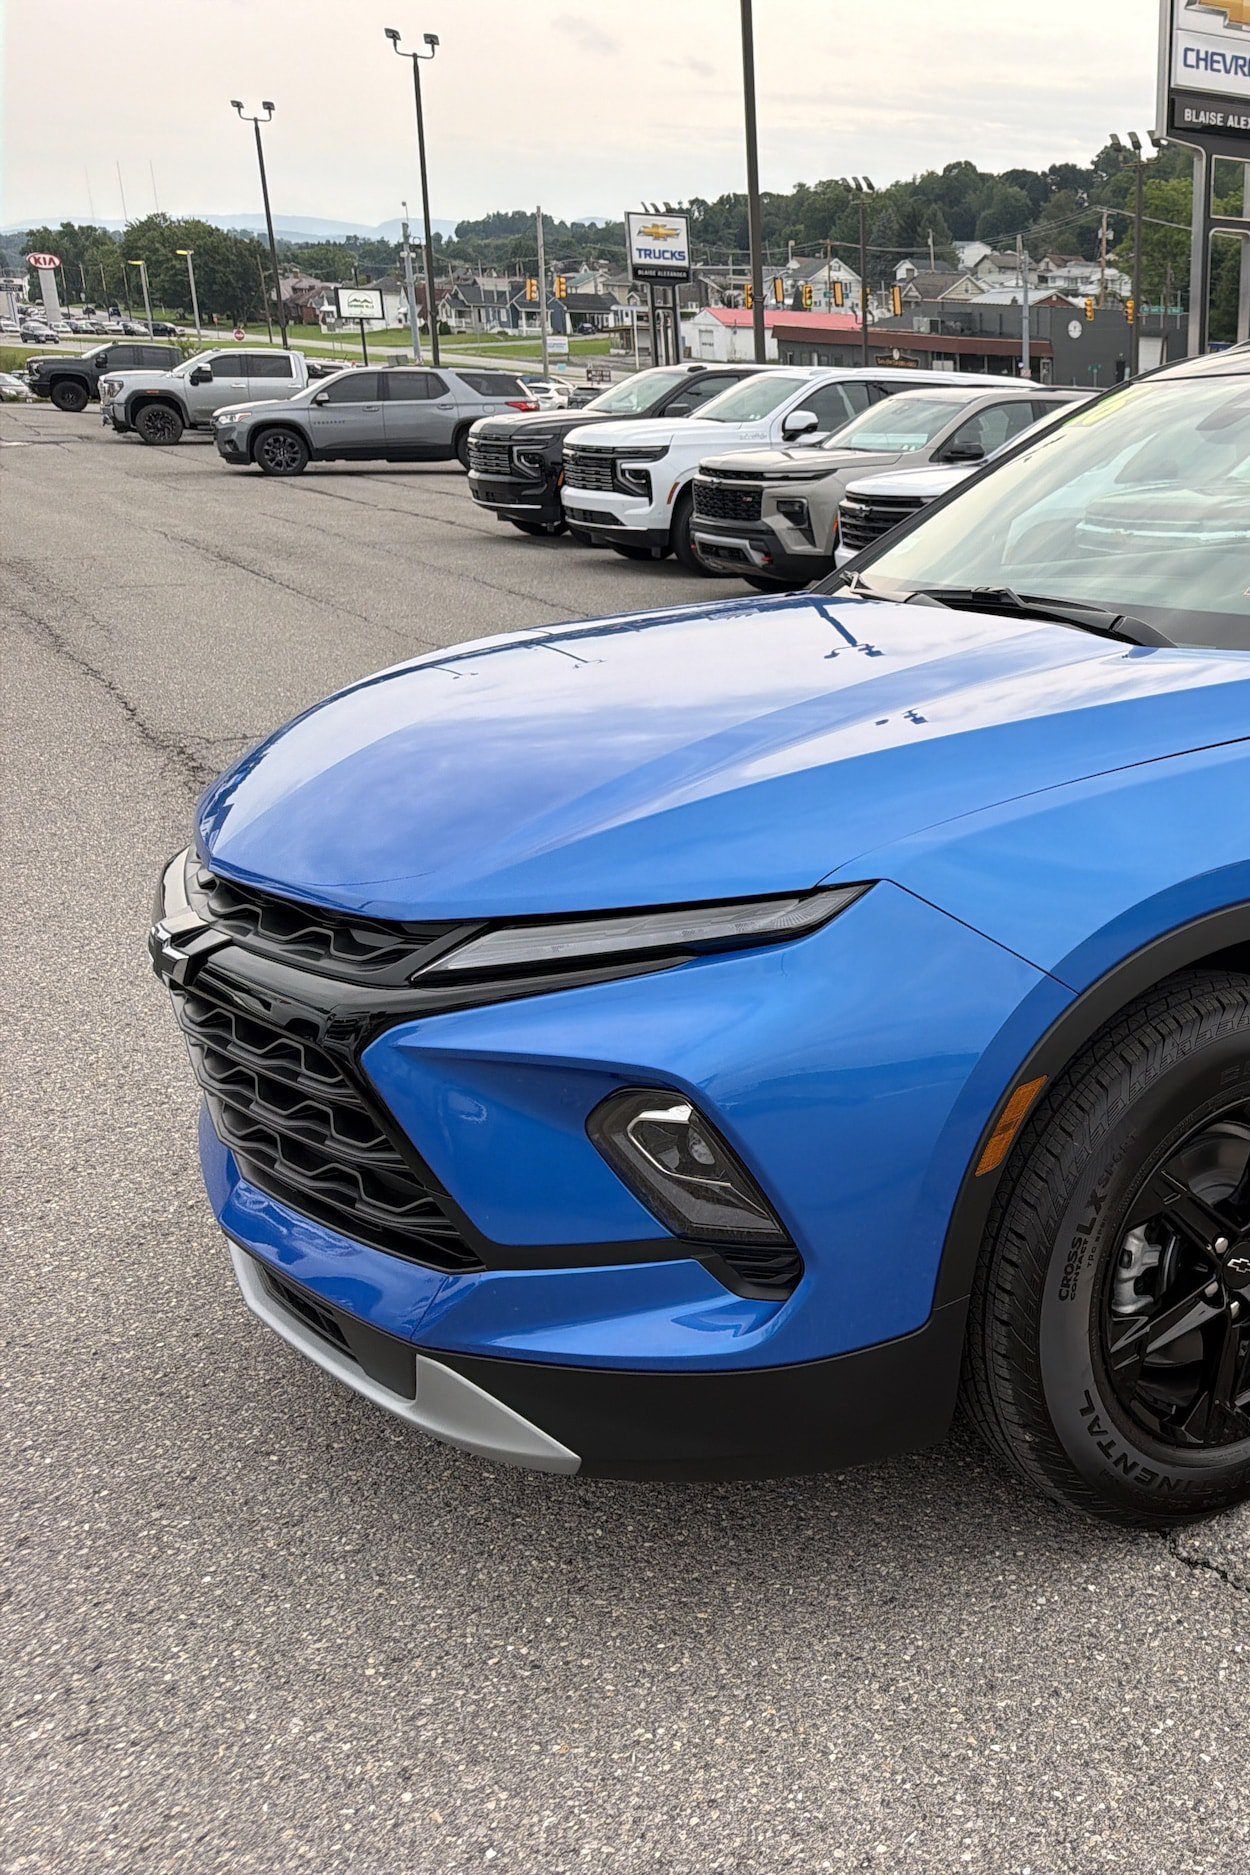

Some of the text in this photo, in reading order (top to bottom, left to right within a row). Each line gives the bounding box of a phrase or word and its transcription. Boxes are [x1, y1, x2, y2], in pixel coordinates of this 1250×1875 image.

[1184, 108, 1224, 126] BLAISE
[33, 256, 57, 266] KIA
[636, 247, 686, 261] TRUCKS
[1058, 1236, 1083, 1302] CROSS
[1070, 1238, 1088, 1302] CONTACT
